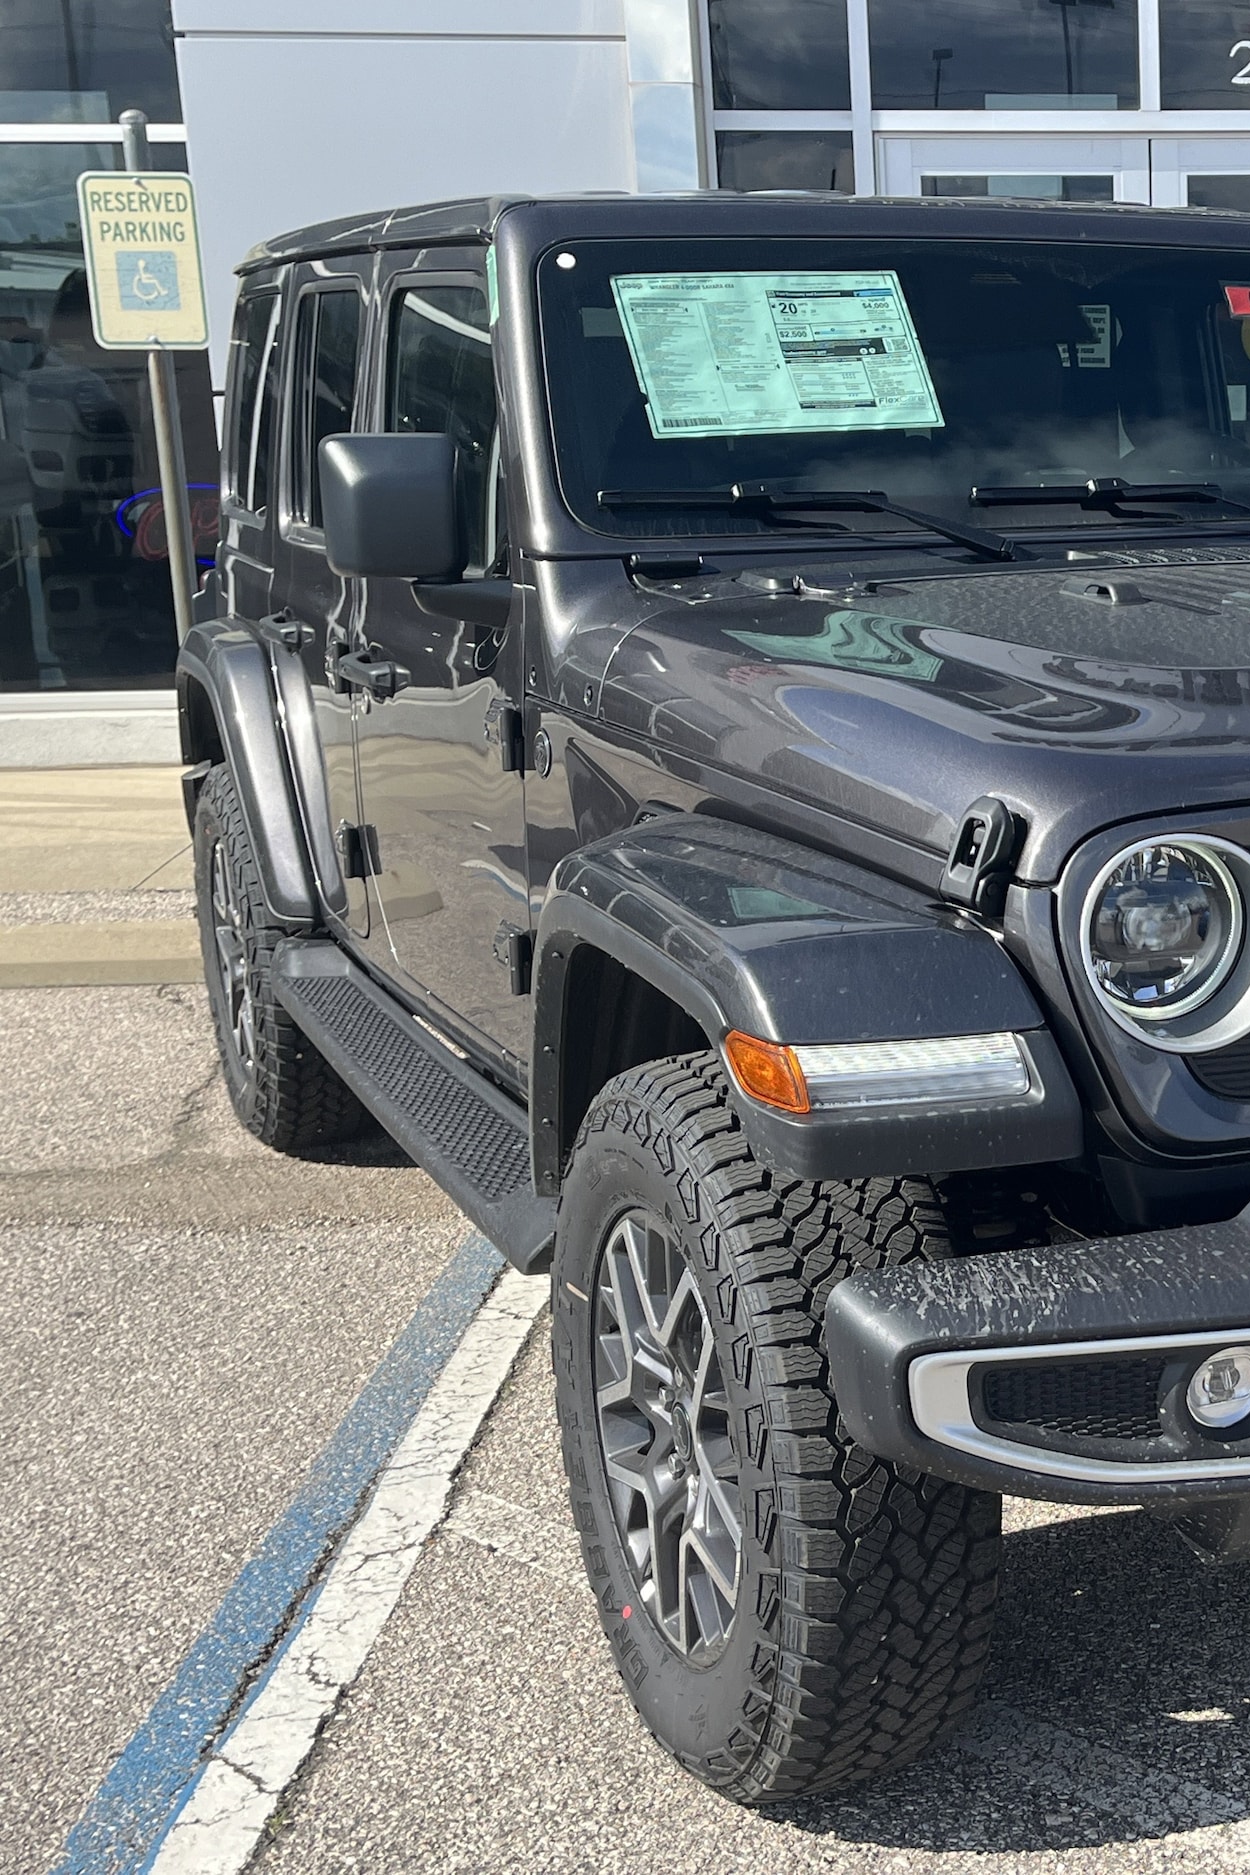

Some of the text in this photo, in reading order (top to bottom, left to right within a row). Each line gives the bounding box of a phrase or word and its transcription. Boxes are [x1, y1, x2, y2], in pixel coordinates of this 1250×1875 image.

[90, 190, 188, 213] RESERVED
[99, 220, 186, 243] PARKING
[778, 302, 798, 314] 20
[878, 395, 925, 405] FlexCare
